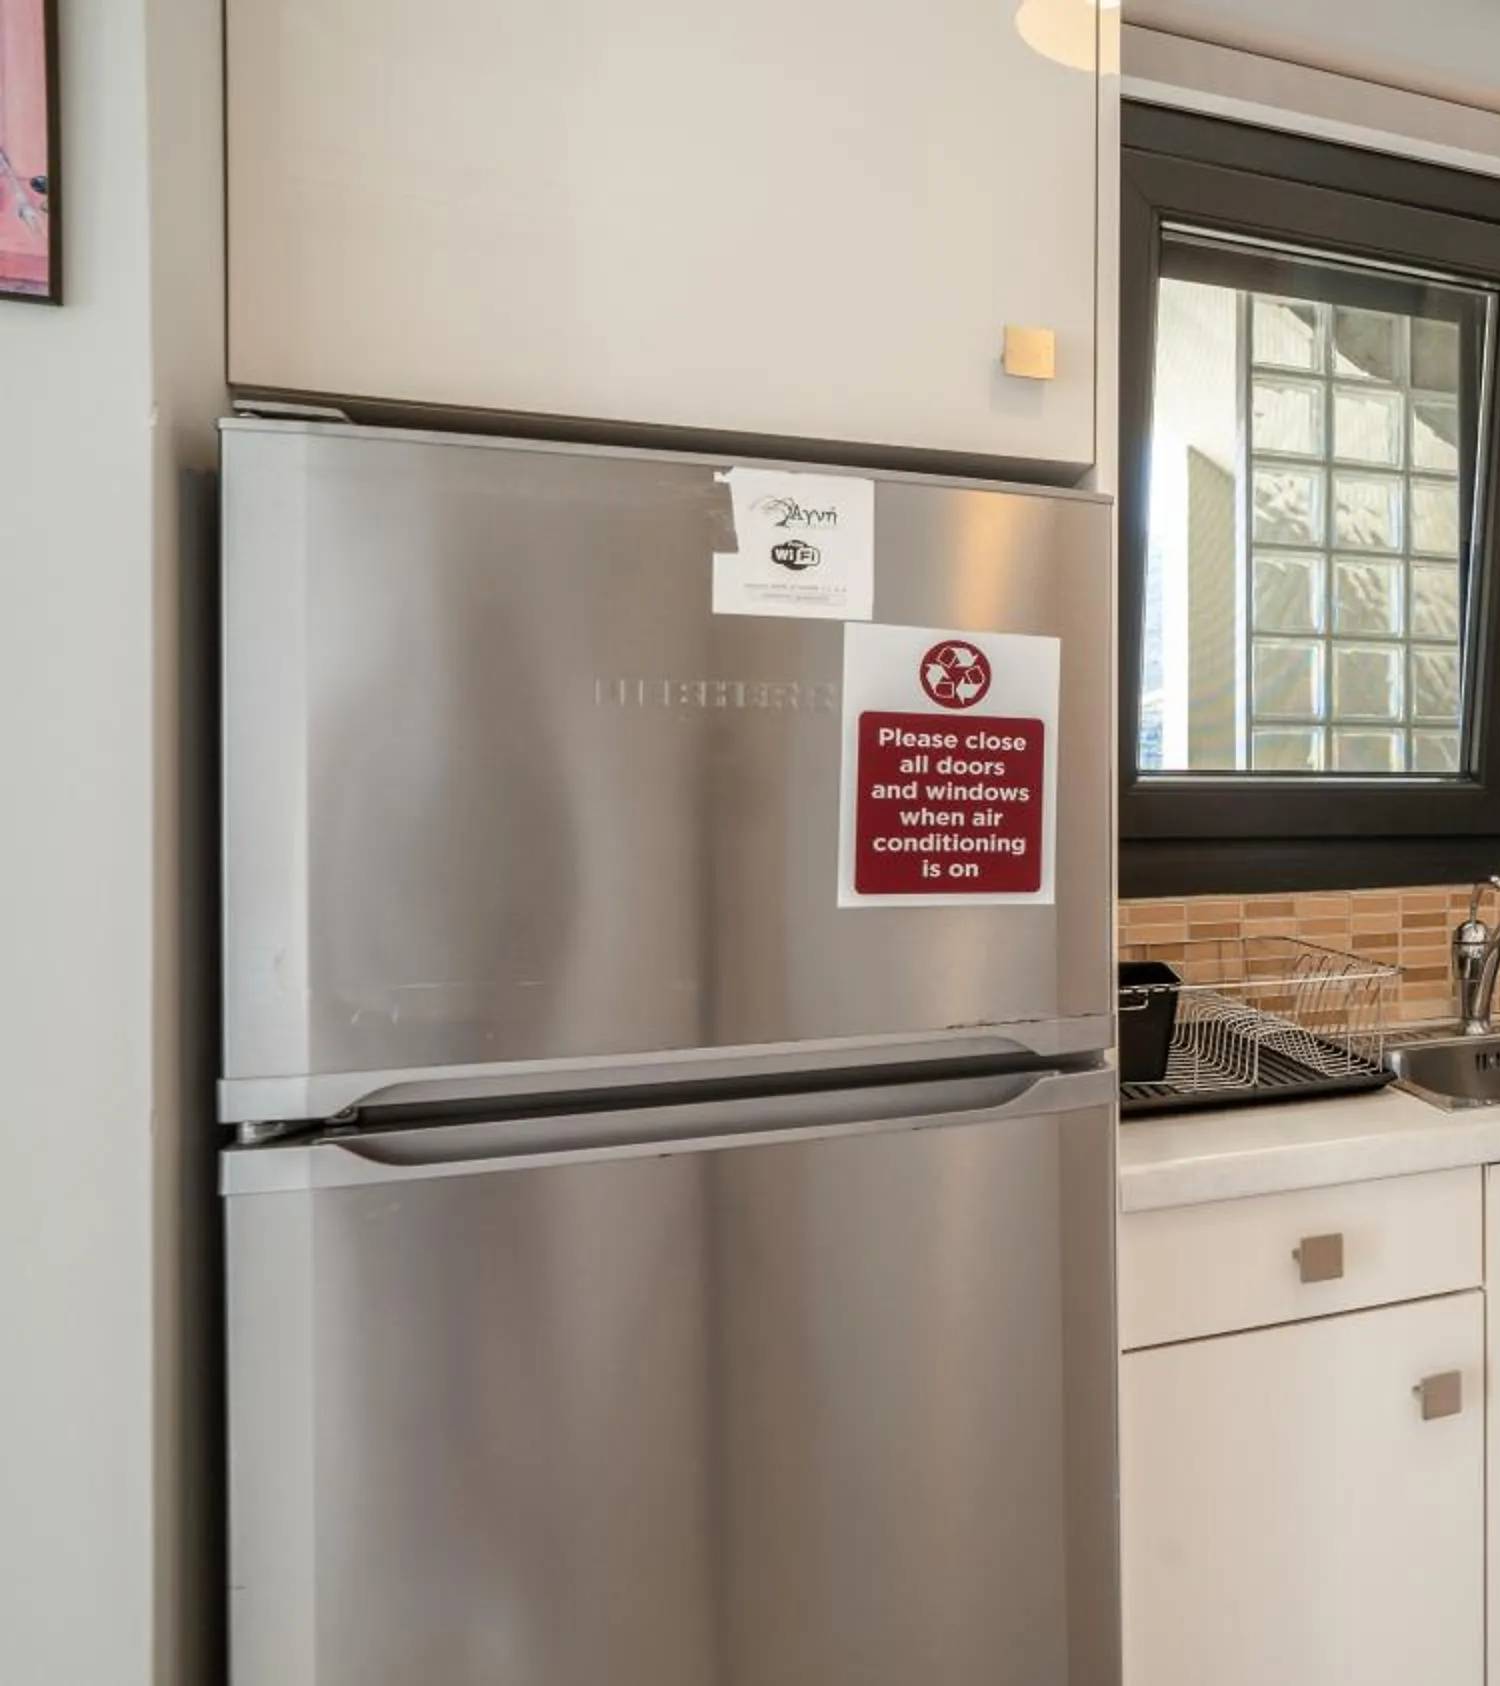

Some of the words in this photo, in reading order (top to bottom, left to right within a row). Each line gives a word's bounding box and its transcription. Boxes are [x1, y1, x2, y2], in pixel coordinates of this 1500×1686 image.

[878, 728, 957, 749] Please
[965, 732, 1027, 751] close
[899, 755, 928, 774] all
[936, 757, 1005, 776] doors
[871, 781, 917, 800] and
[926, 782, 1030, 802] windows
[899, 808, 965, 827] when
[972, 809, 1003, 828] air
[872, 833, 1026, 855] conditioning
[922, 860, 941, 878] is
[949, 864, 979, 878] on
